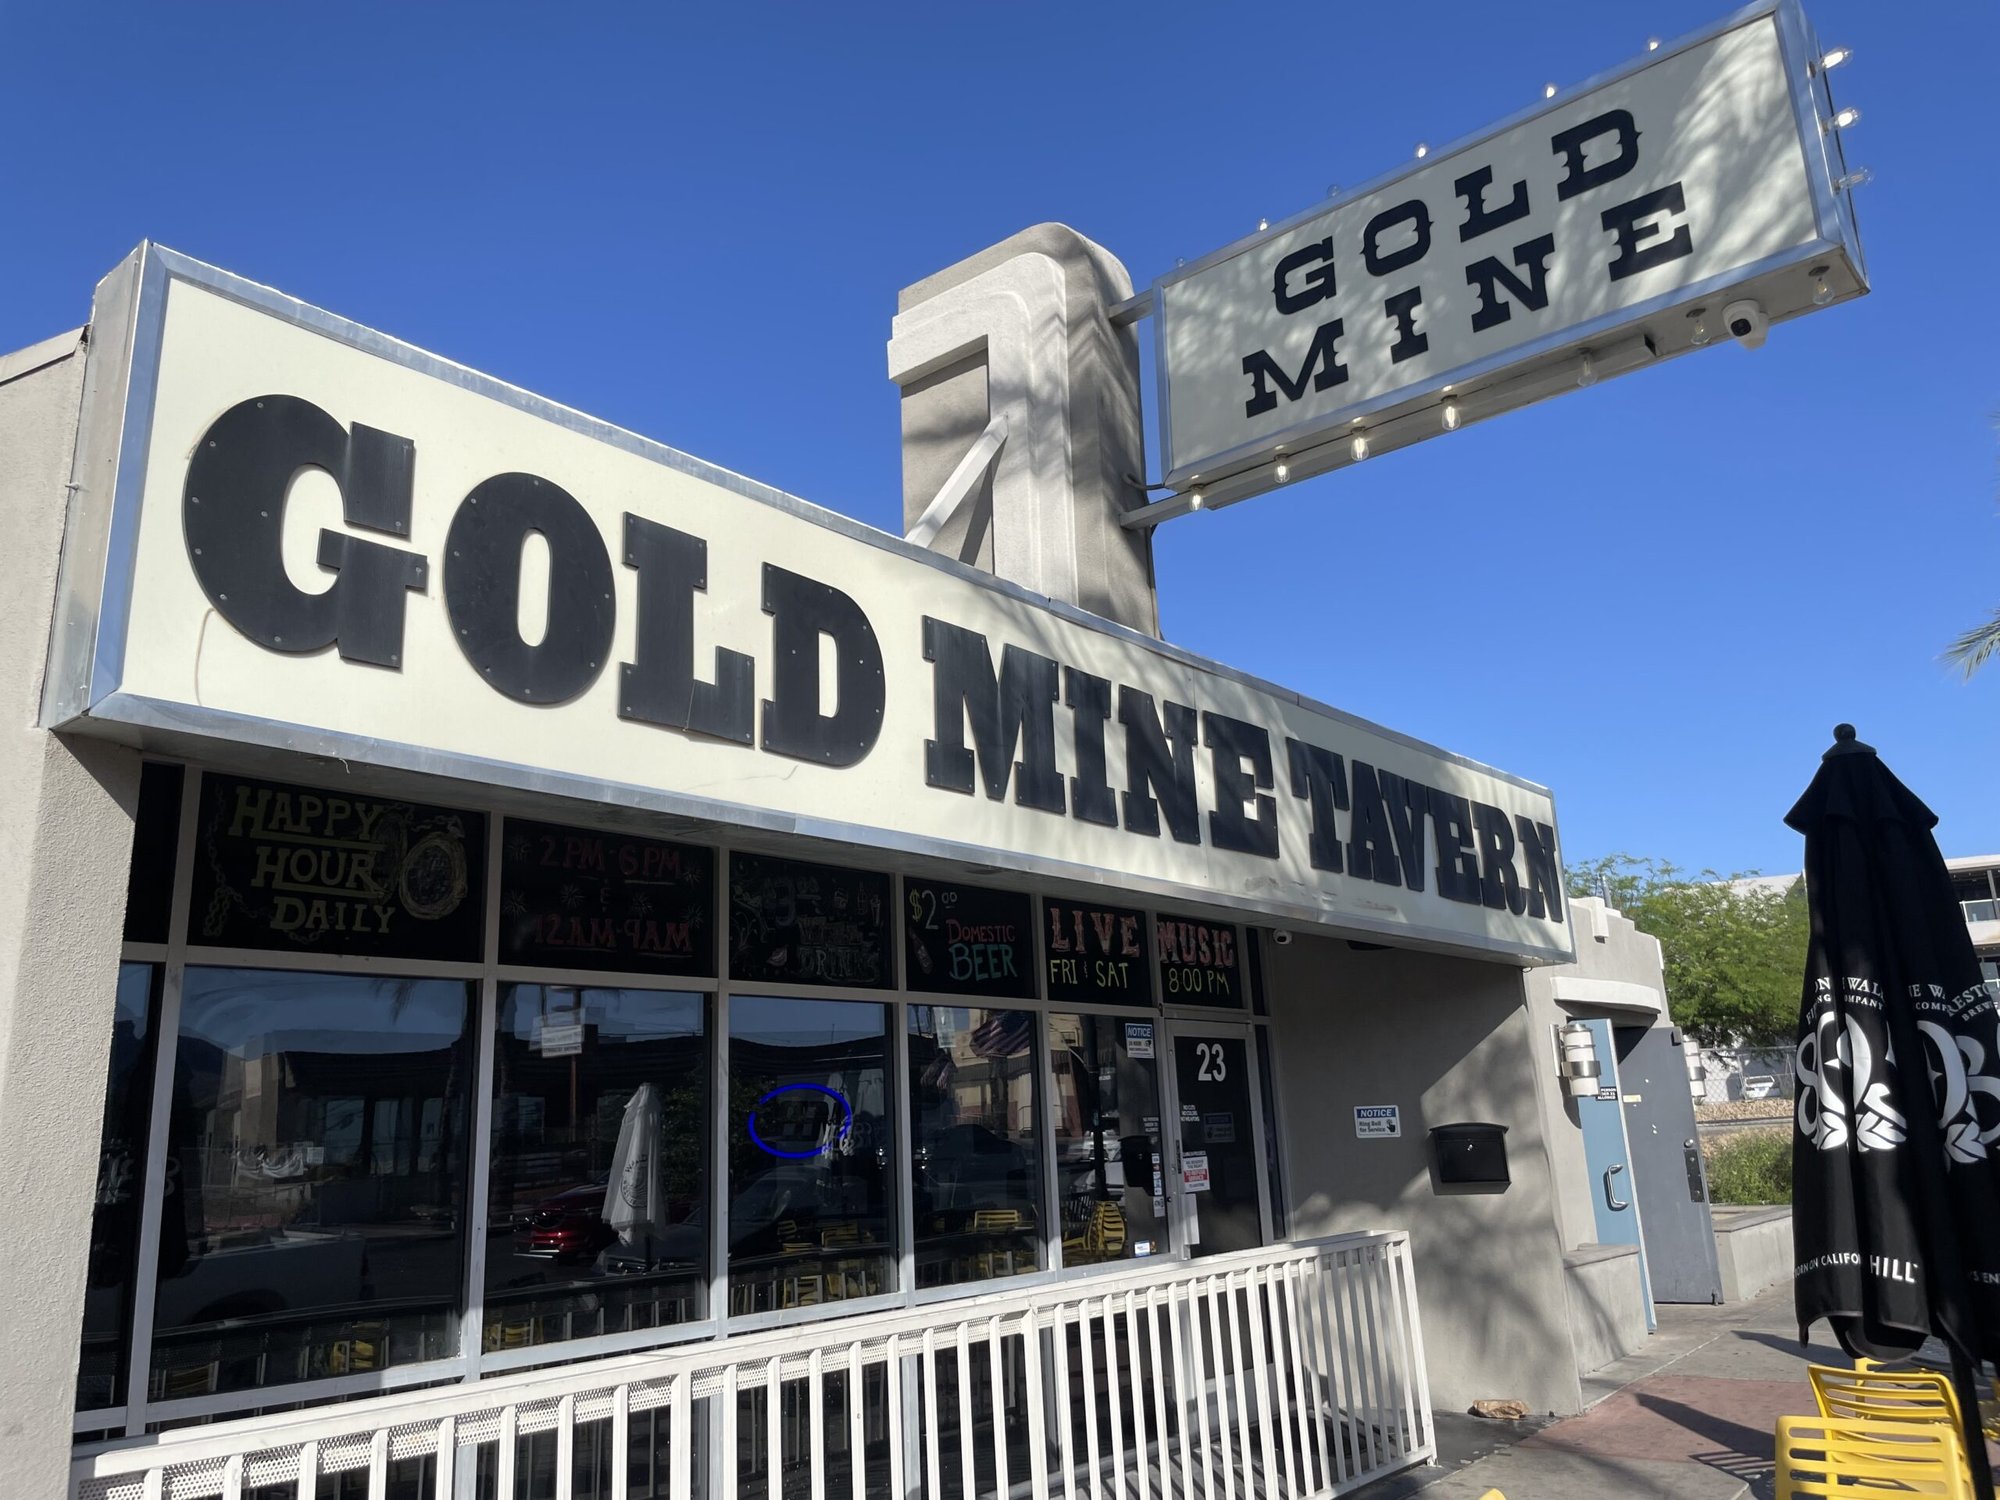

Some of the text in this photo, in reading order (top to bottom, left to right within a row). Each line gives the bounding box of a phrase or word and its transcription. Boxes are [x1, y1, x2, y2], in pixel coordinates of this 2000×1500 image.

[1272, 109, 1642, 316] GOLD
[1243, 181, 1693, 419] MINE
[182, 394, 1563, 924] GOLD MINE TAVERN
[226, 784, 386, 841] HAPPY
[250, 846, 385, 896] HOUR
[270, 895, 397, 935] DAILY
[945, 918, 1017, 944] DOMESTIC
[1049, 907, 1141, 958] LIVE
[948, 943, 1019, 982] BEER
[1157, 920, 1234, 968] MUSIC
[1049, 959, 1078, 985] FRI
[1095, 961, 1129, 990] SAT
[1207, 970, 1230, 996] PM
[1847, 977, 1885, 1002] WAL
[1844, 994, 1884, 1011] OMPANY
[1128, 1026, 1152, 1037] NOTICE
[1196, 1042, 1227, 1082] 23
[1360, 1108, 1392, 1118] NOTICE
